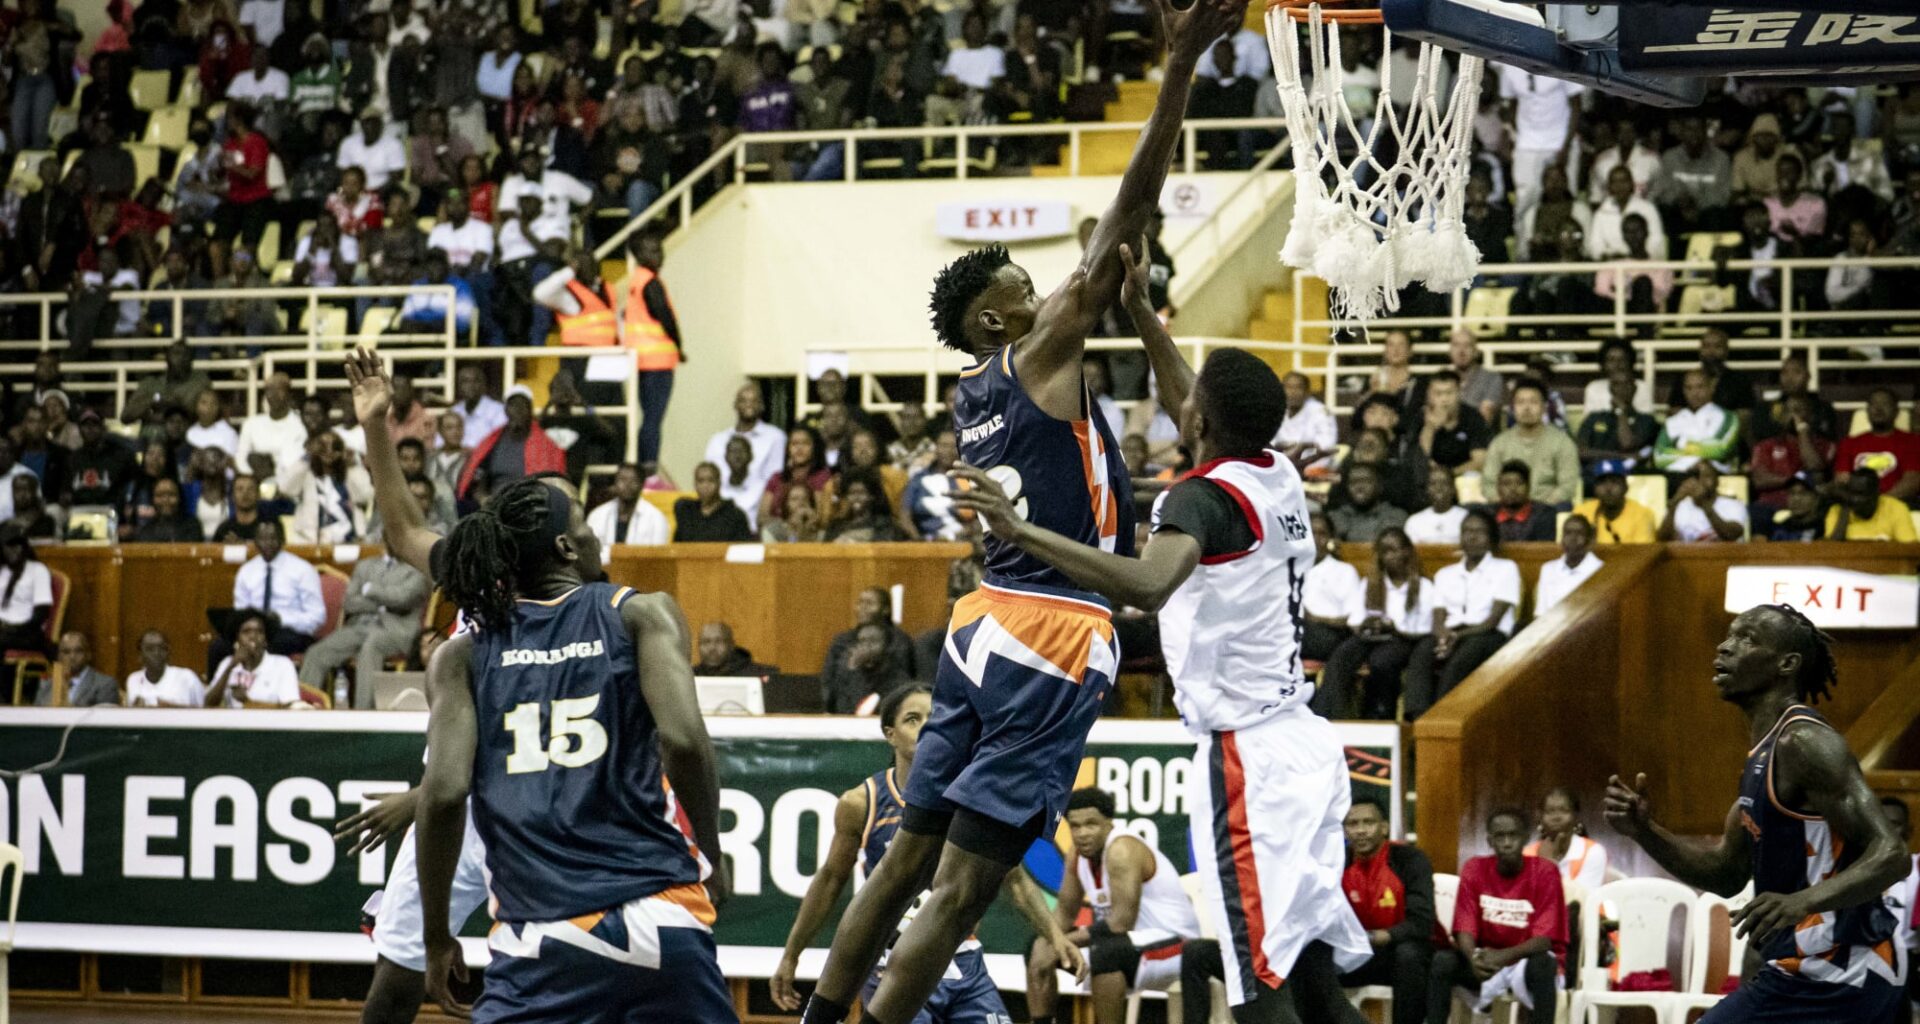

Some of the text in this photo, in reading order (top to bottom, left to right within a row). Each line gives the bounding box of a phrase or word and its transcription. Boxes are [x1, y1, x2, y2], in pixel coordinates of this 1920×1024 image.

[965, 208, 1037, 228] EXIT
[1772, 581, 1873, 612] EXIT
[504, 693, 608, 775] 15
[0, 774, 85, 876] N
[122, 775, 410, 885] EAST
